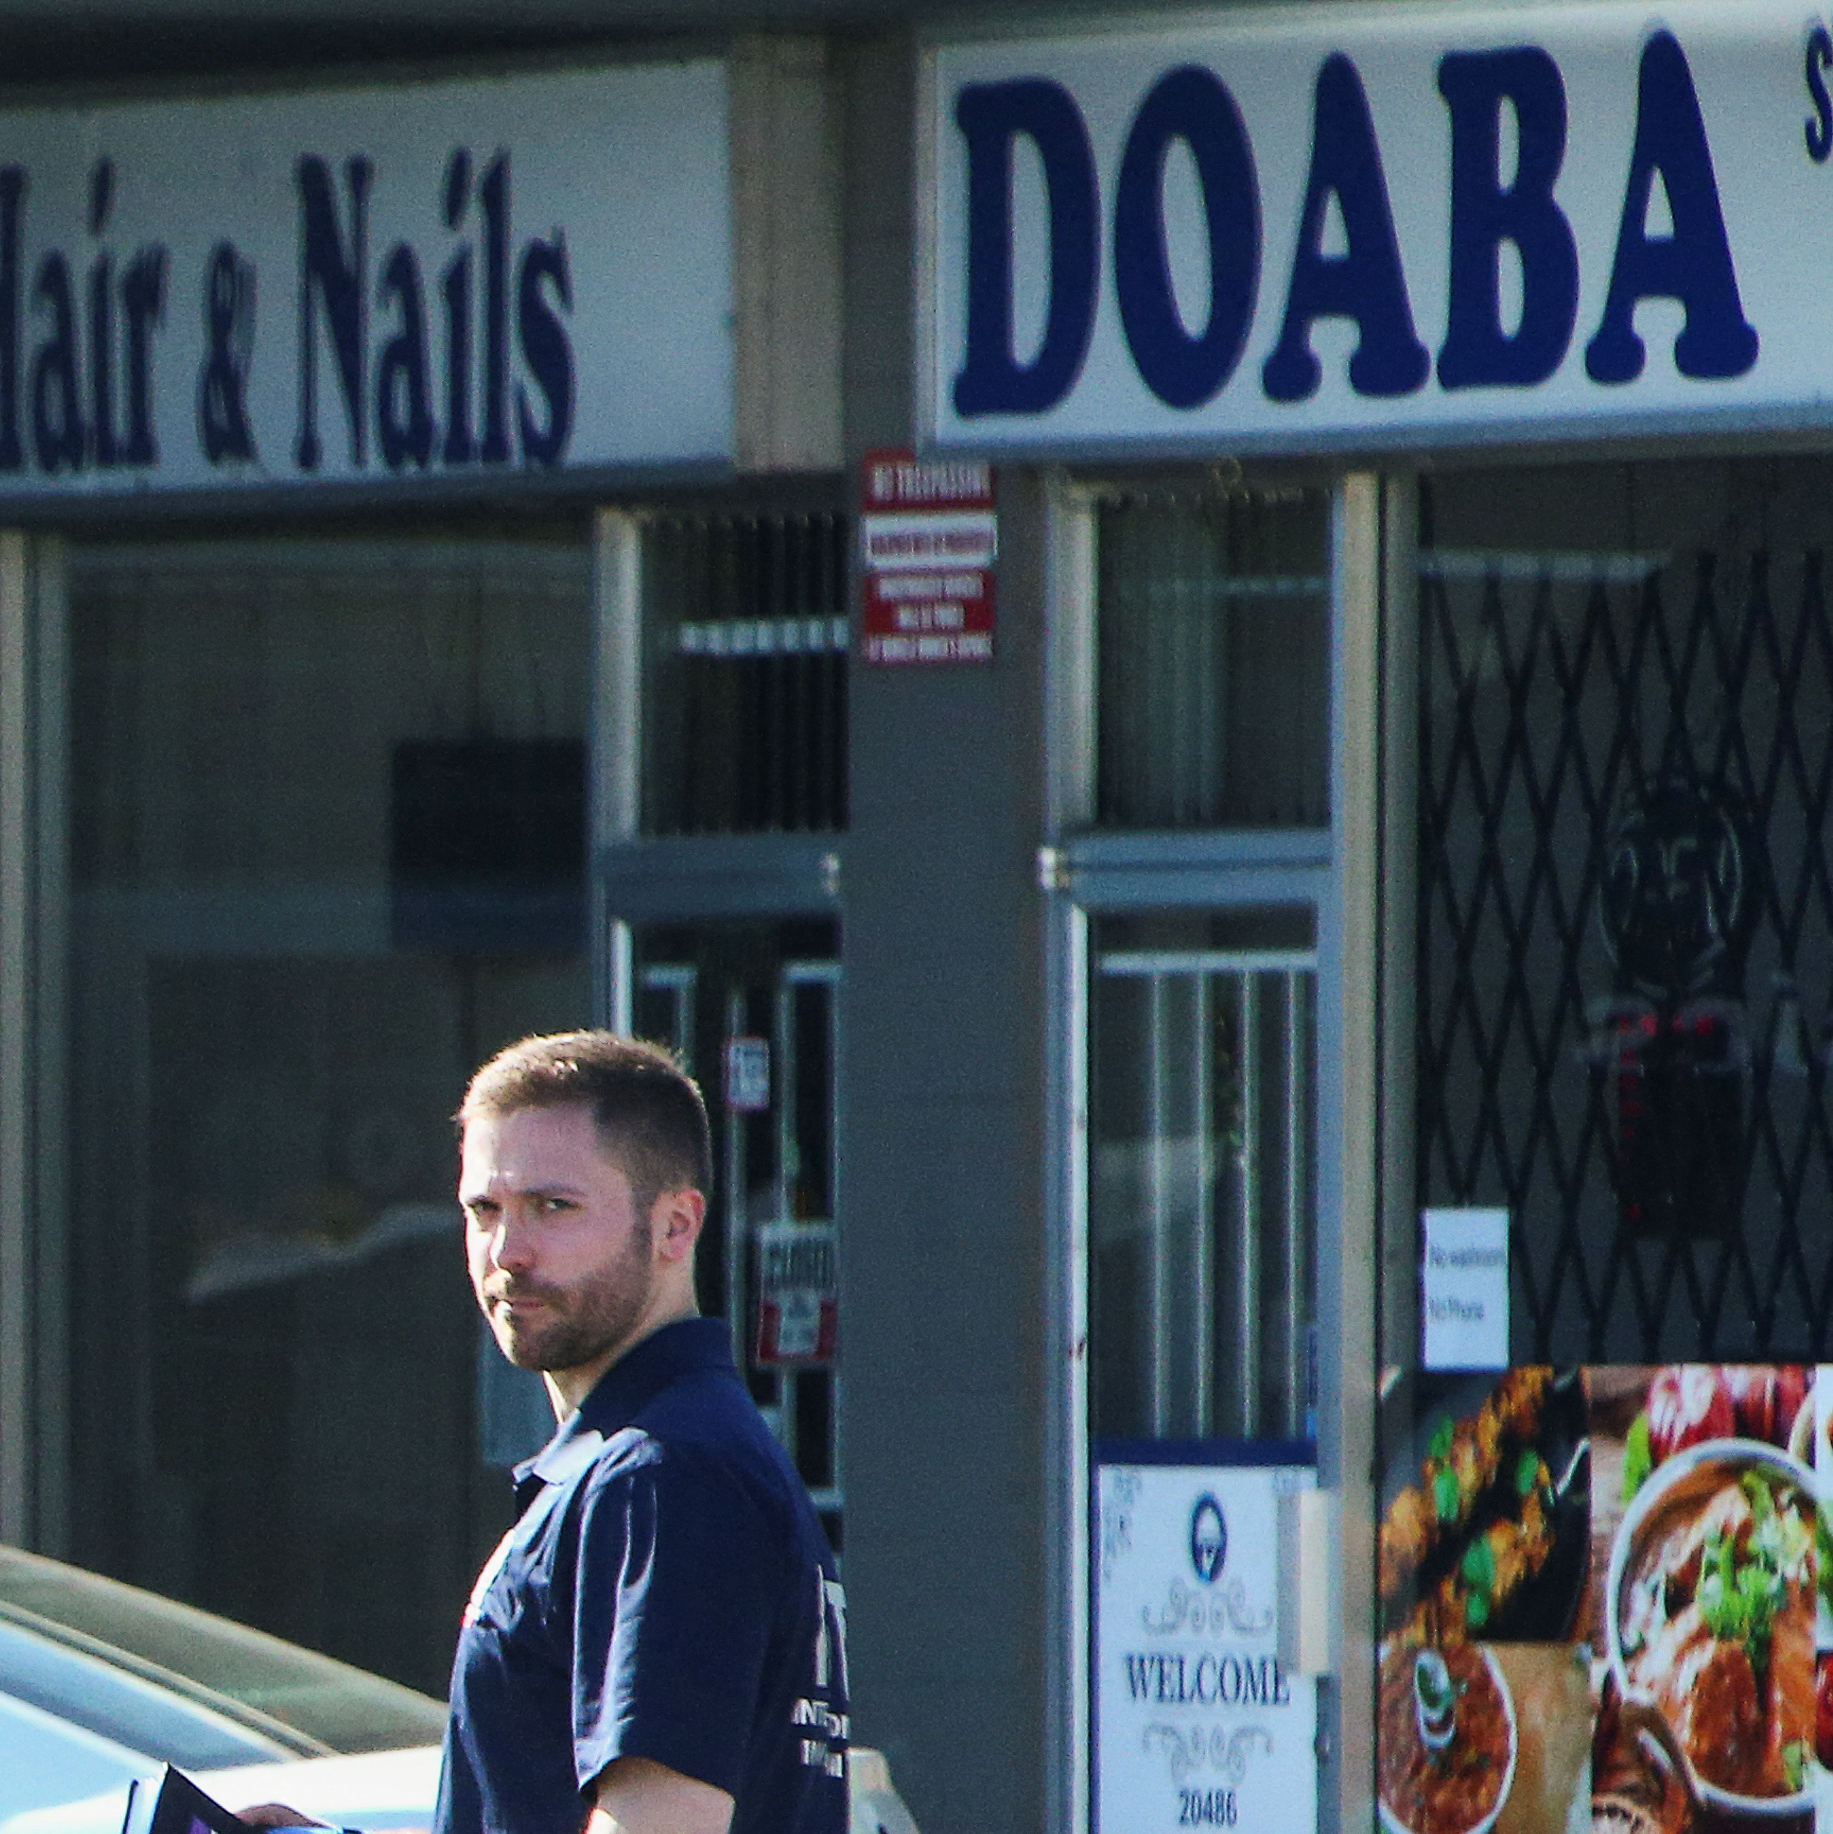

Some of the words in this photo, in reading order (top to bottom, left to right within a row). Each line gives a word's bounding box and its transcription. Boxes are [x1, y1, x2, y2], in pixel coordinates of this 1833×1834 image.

[199, 243, 257, 468] &
[298, 148, 573, 472] Nails
[953, 30, 1760, 420] DOABA
[1126, 1652, 1291, 1706] WELCOME
[1179, 1787, 1238, 1828] 20486
